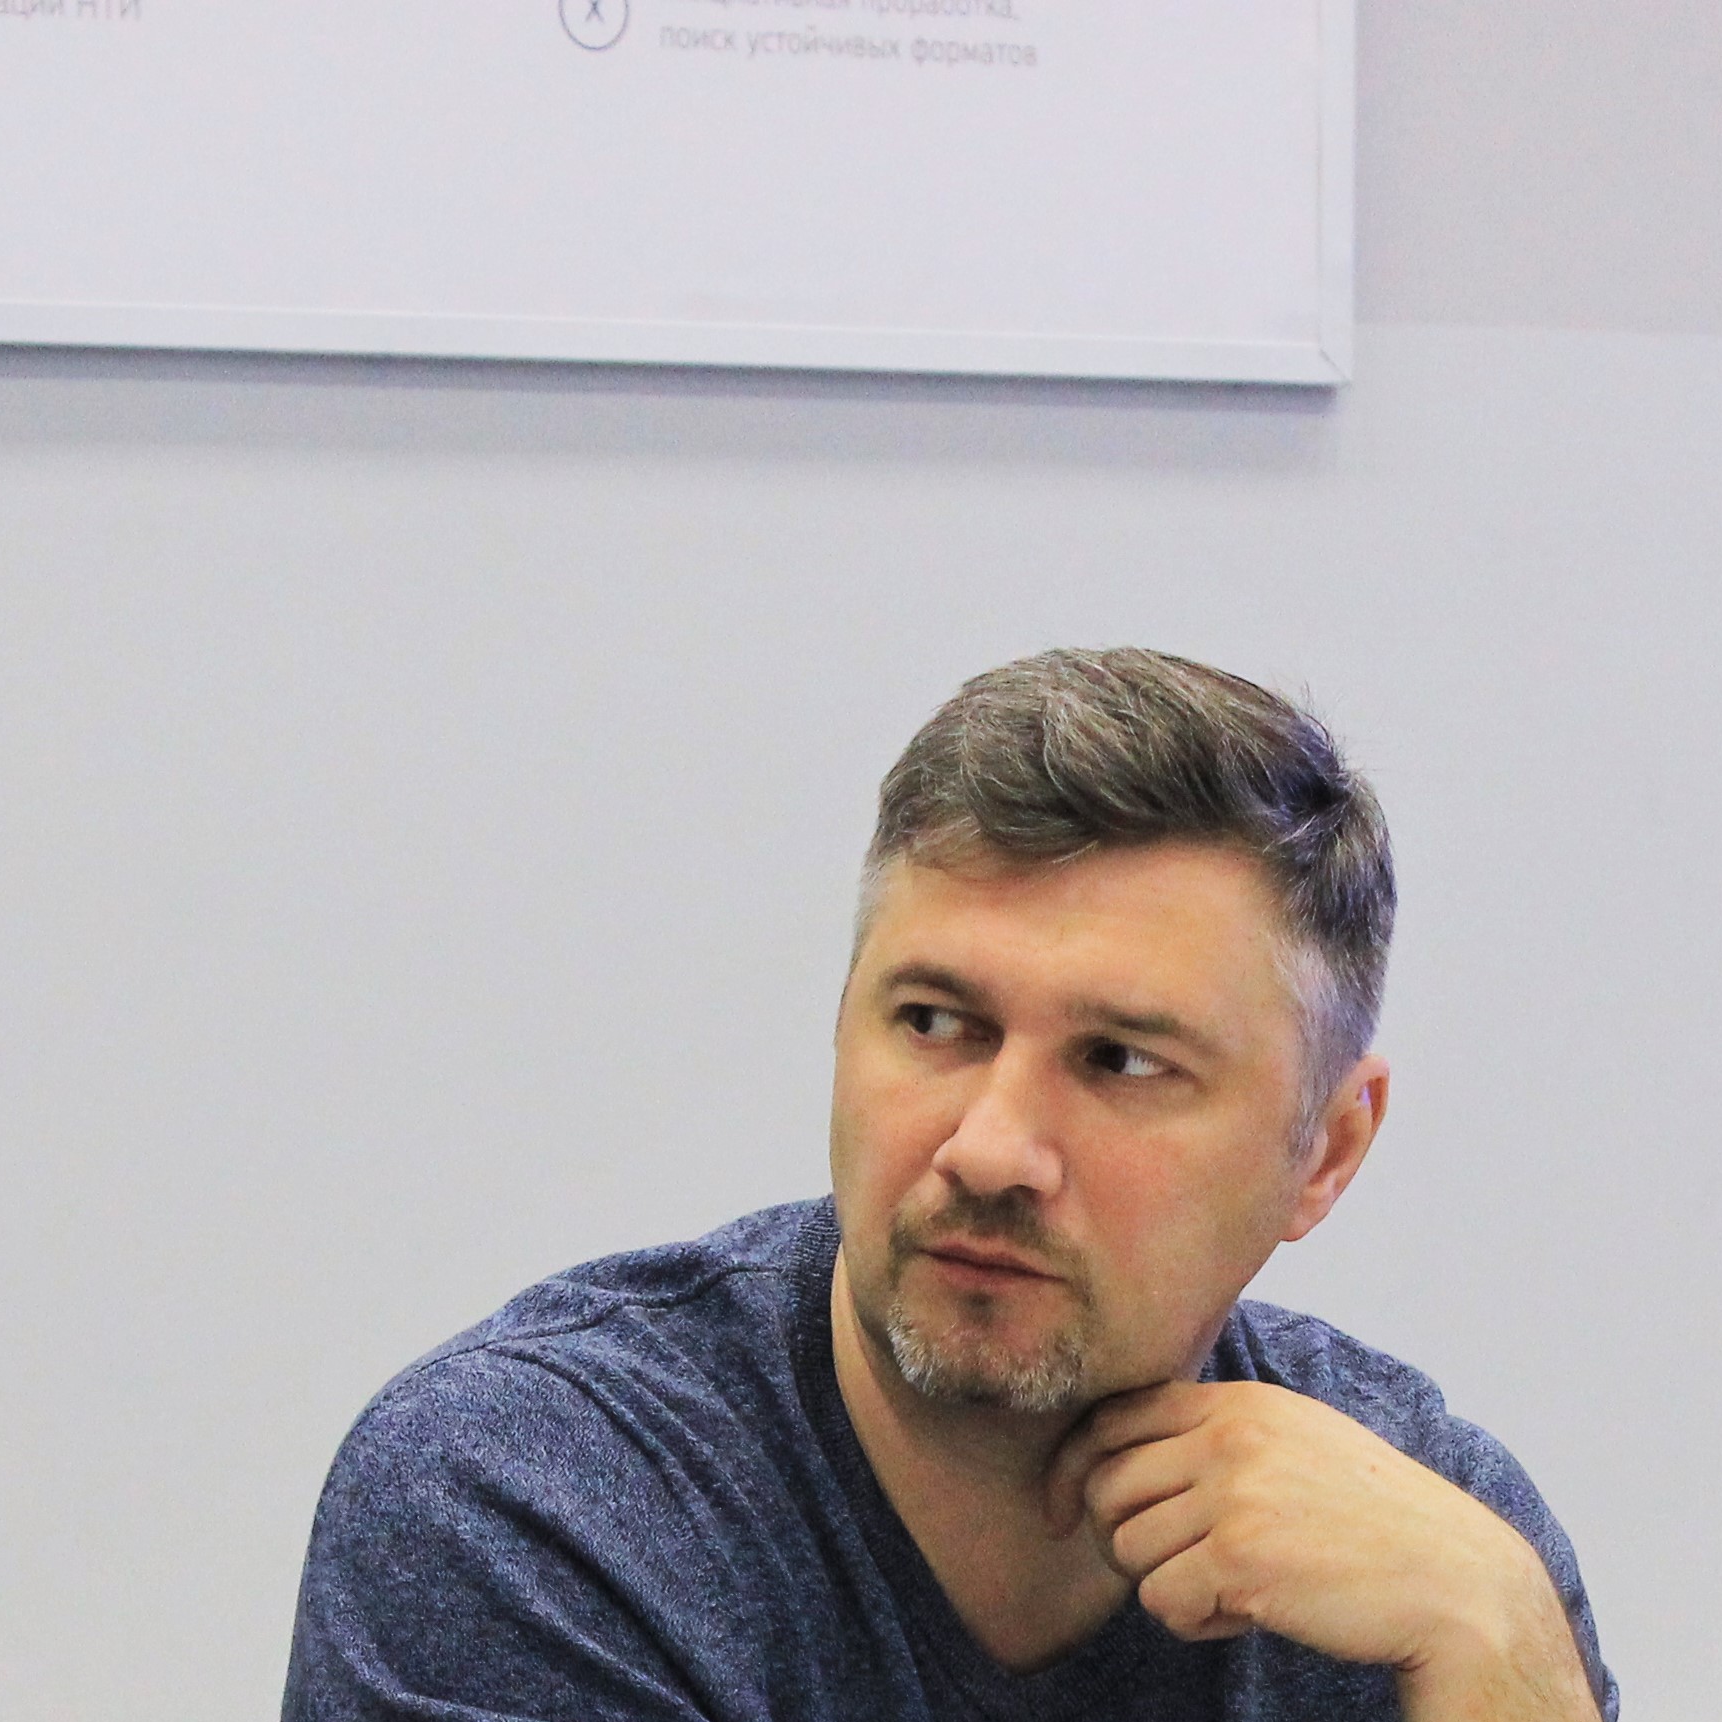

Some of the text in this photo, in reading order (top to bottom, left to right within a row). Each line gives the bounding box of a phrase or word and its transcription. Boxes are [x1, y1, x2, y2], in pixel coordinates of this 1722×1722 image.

[659, 25, 1038, 69] поиск устойчивых форматов
